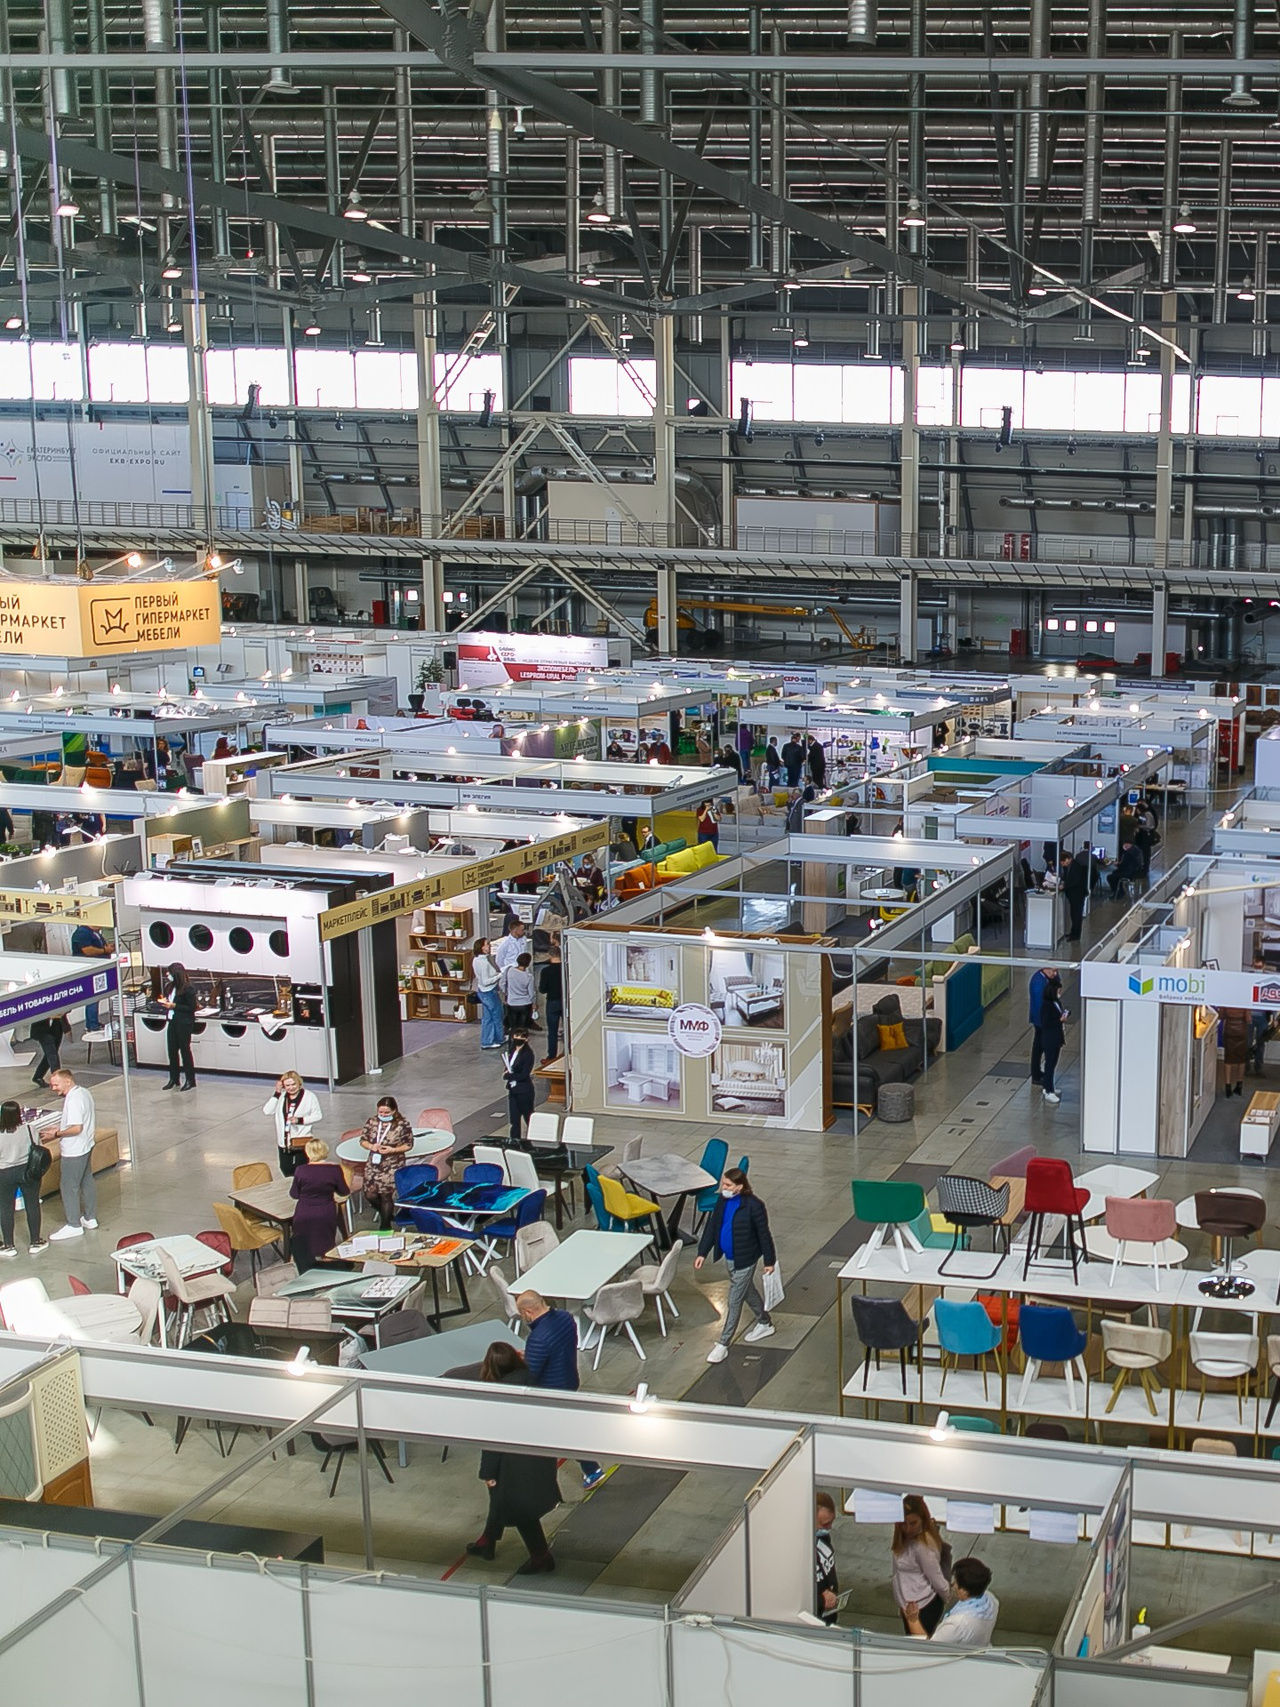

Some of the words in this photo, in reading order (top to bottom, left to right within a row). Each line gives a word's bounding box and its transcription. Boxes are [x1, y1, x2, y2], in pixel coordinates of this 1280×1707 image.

[160, 448, 182, 457] САЙТ
[109, 458, 166, 466] EKB-EXPORU
[134, 591, 179, 609] ПЕРВЫЙ
[135, 607, 211, 626] ГИПЕРМАРКЕТ
[137, 626, 181, 642] МЕБЕЛИ
[323, 906, 369, 932] МАРКЕТПЛЕЙС
[1158, 972, 1206, 994] mobi
[24, 995, 53, 1010] ТОВАРЫ
[53, 990, 68, 1002] ДЛЯ
[69, 984, 84, 996] СНА
[680, 1019, 709, 1031] ММФ
